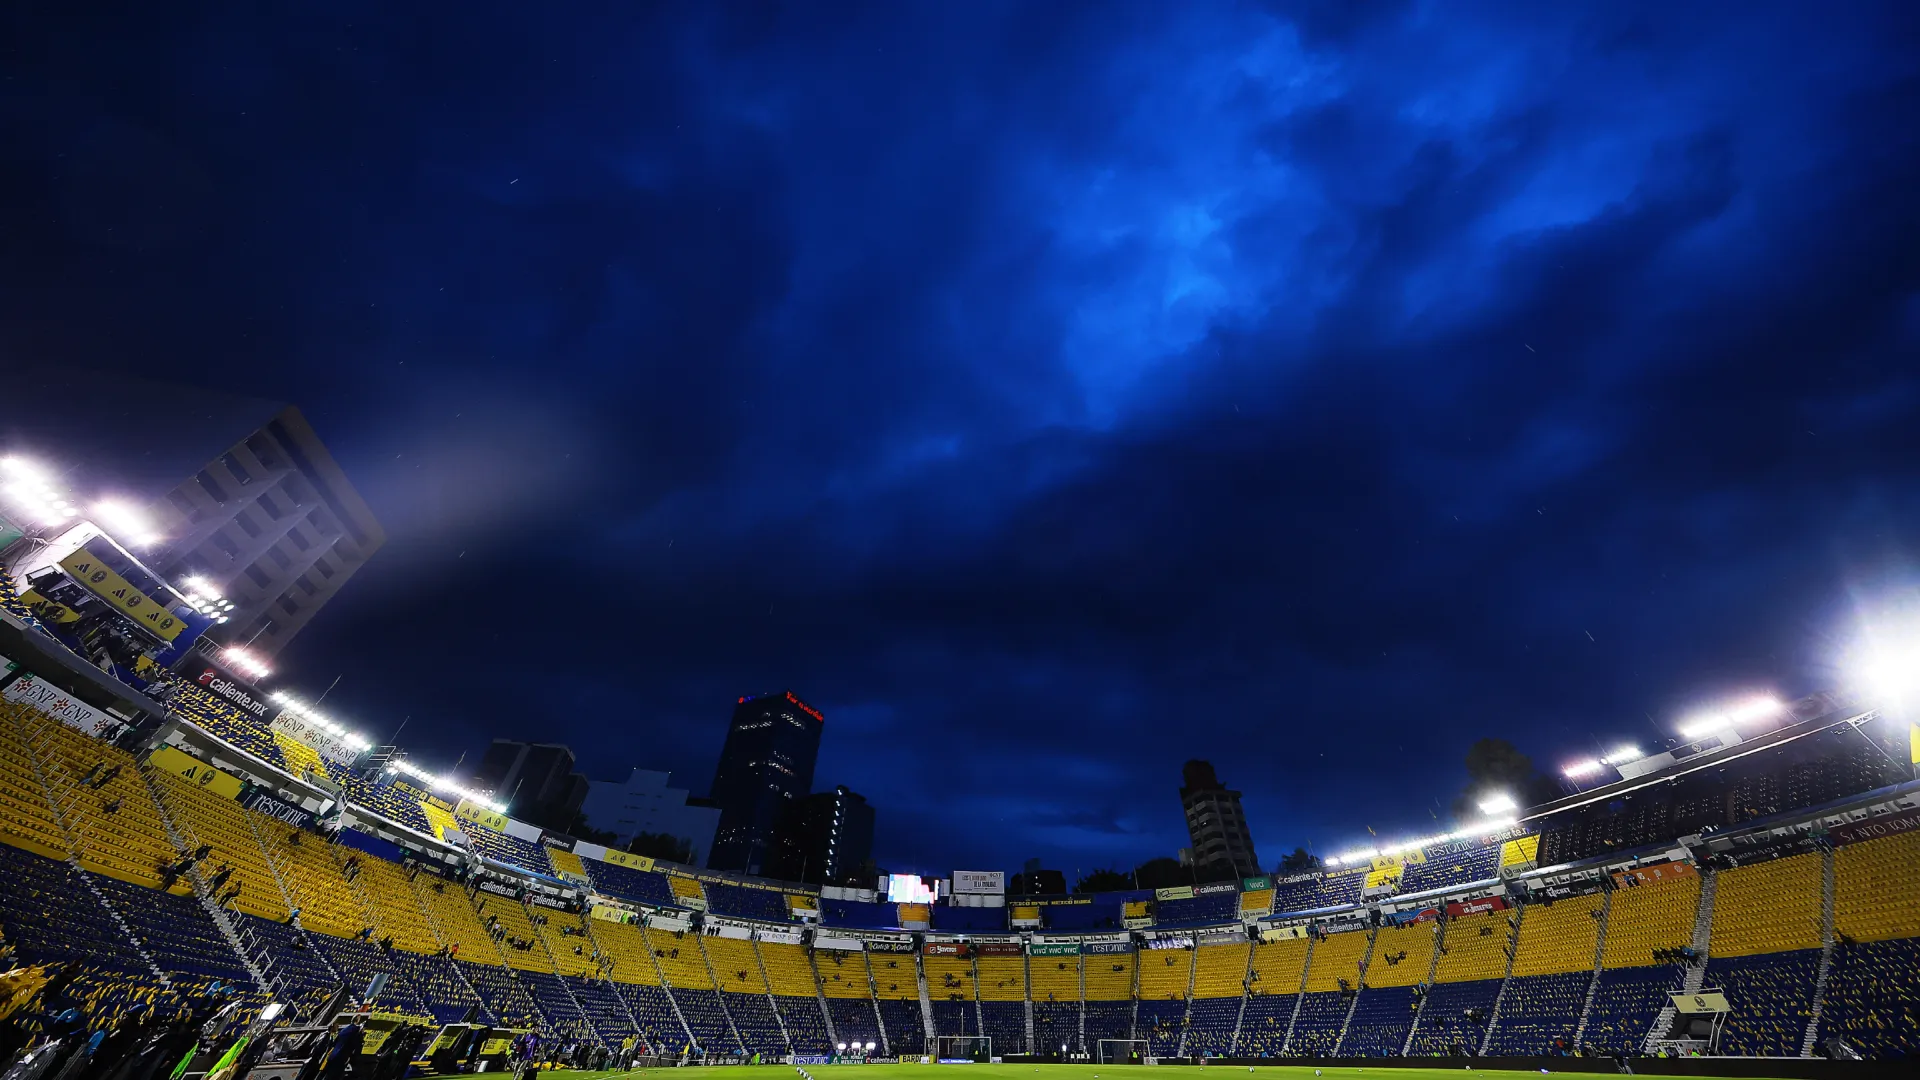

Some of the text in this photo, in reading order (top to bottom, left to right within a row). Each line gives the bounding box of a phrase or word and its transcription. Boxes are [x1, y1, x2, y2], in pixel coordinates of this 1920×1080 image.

[25, 684, 57, 703] GNP
[209, 678, 268, 716] caliente.mx
[62, 703, 92, 722] GNP
[283, 717, 305, 733] GNP
[311, 733, 331, 748] GNP
[337, 747, 356, 761] GNP
[1283, 871, 1324, 884] caliente.mx
[1200, 883, 1235, 893] caliente.mx
